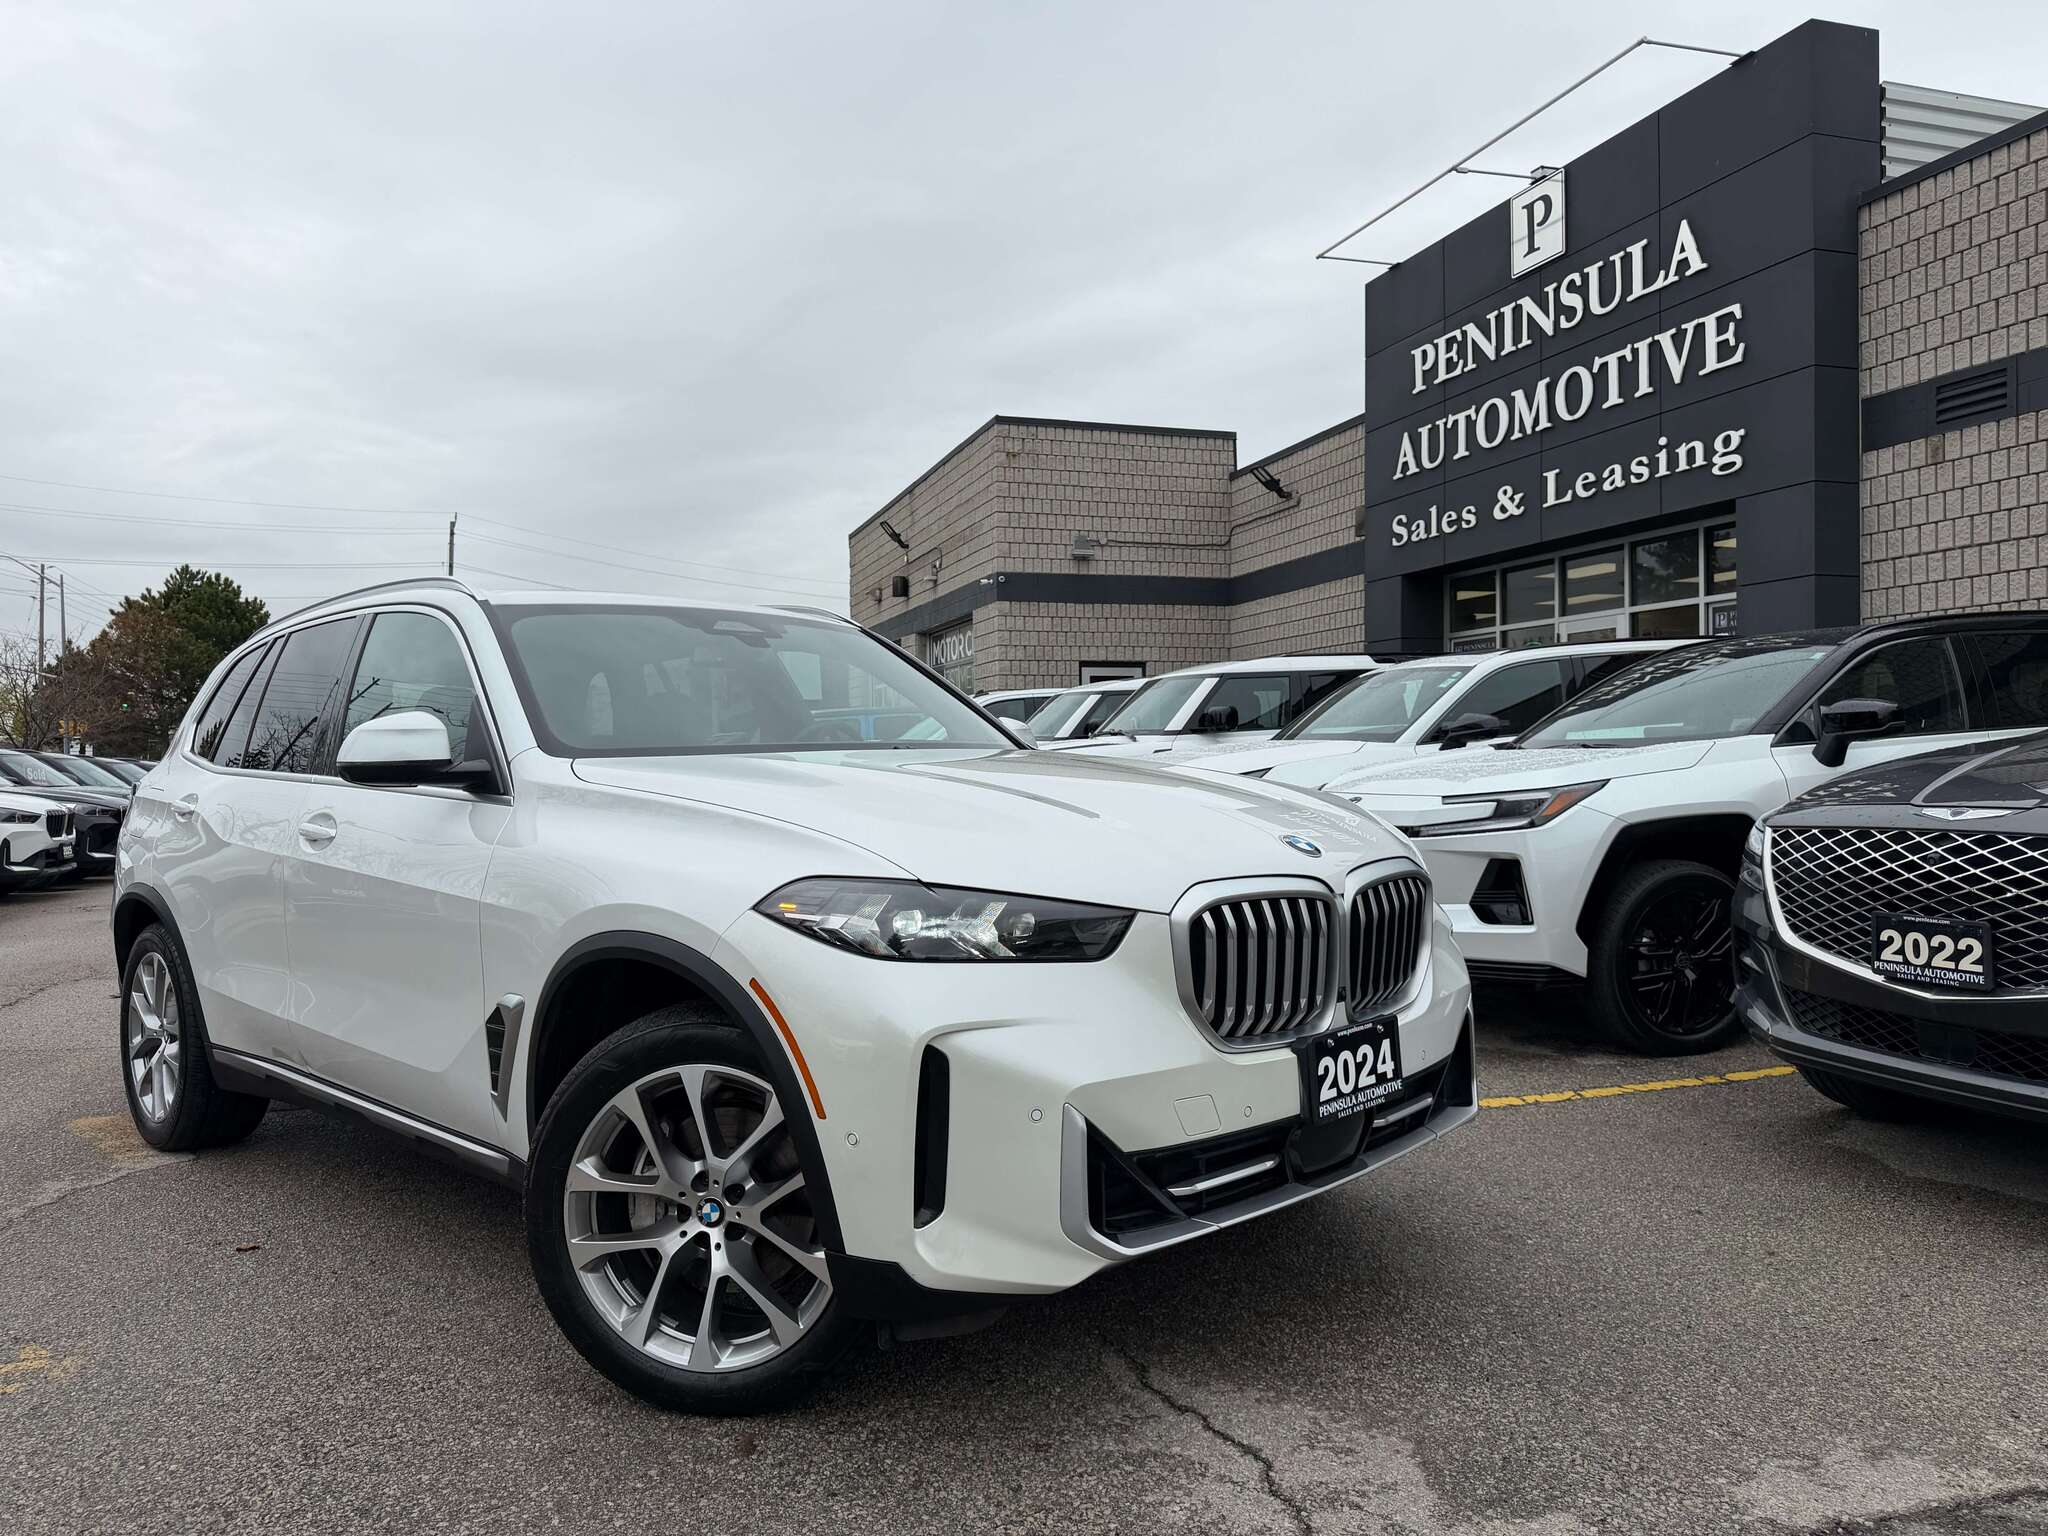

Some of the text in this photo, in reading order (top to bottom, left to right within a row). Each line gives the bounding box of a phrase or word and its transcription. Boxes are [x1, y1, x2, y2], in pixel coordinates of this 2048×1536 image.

[1522, 194, 1553, 258] P
[1411, 218, 1709, 395] PENINSULA
[1392, 303, 1747, 481] AUTOMOTIVE
[1391, 428, 1747, 547] Sales & Leasing
[26, 767, 47, 781] Sold
[1874, 961, 1985, 985] PENINSULA AUTOMOTIVE
[1879, 928, 1984, 973] 2022
[1932, 979, 1960, 987] LEASING
[1317, 1038, 1395, 1103] 2024
[1319, 1079, 1403, 1118] PENINSULA AUTOMOTIVE
[1338, 1097, 1386, 1119] SALES AND LEASING
